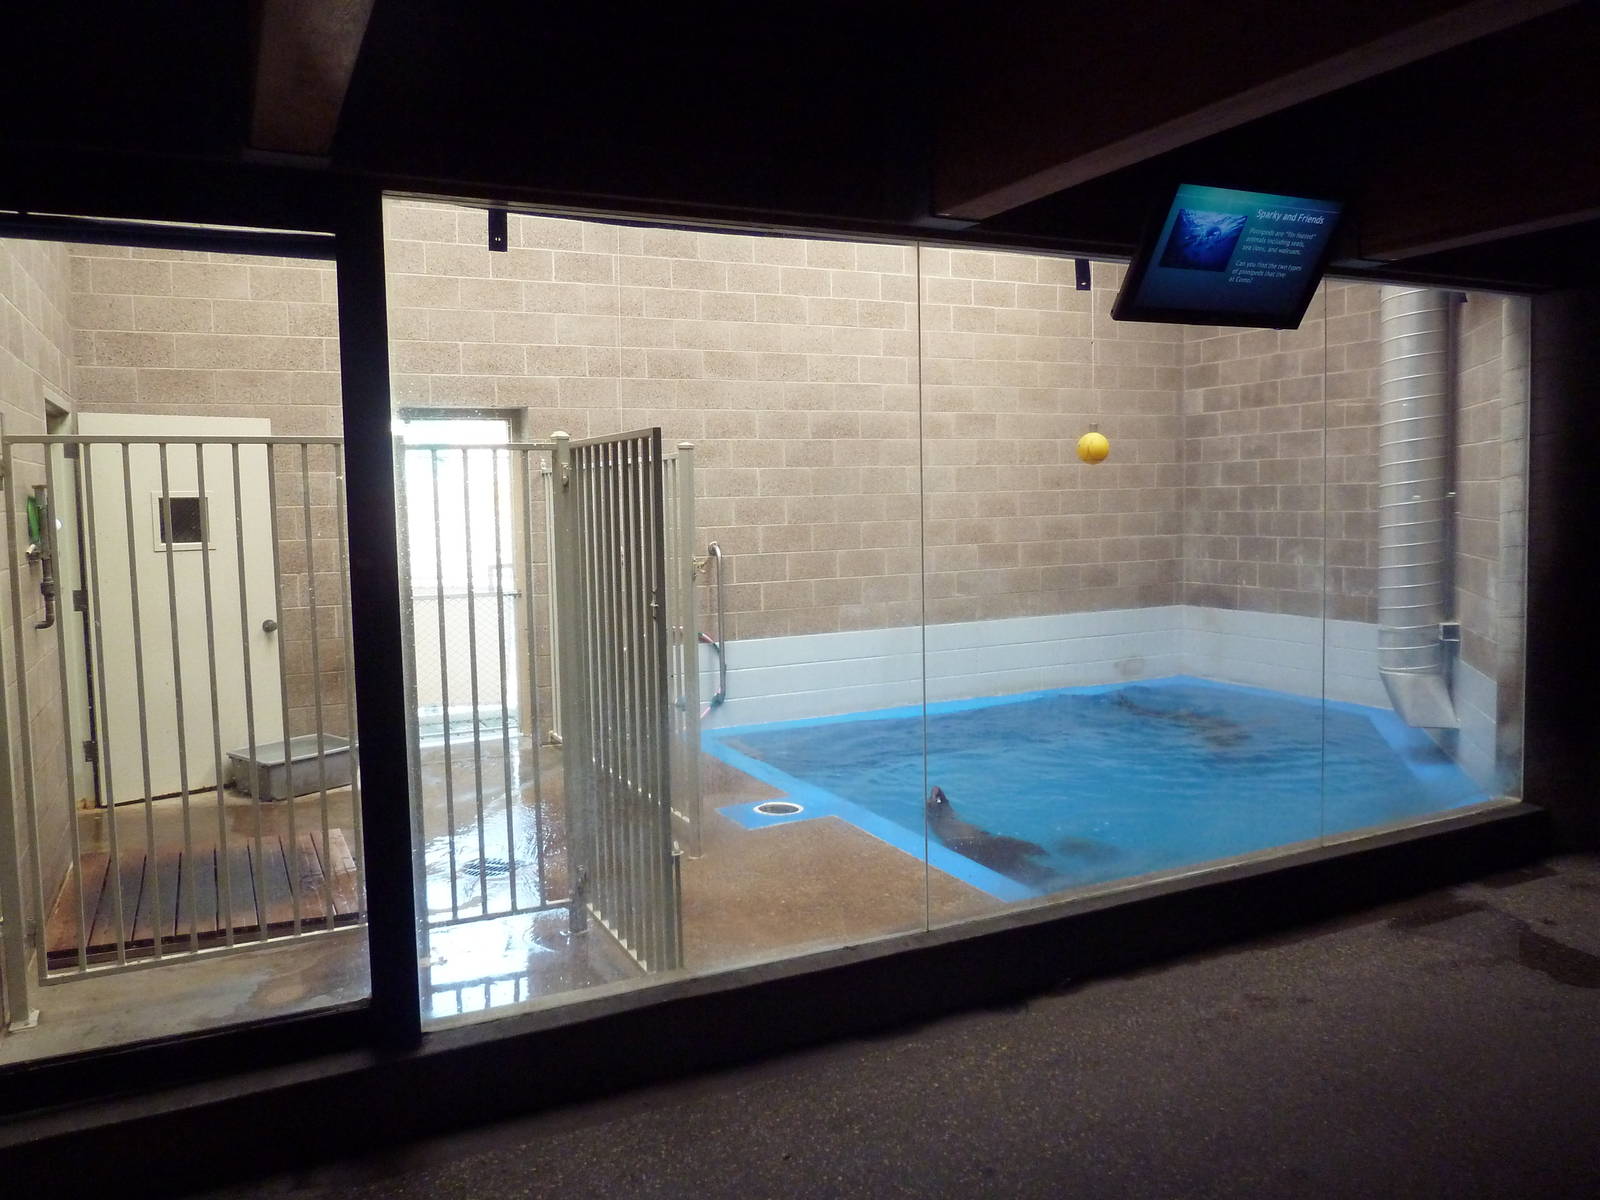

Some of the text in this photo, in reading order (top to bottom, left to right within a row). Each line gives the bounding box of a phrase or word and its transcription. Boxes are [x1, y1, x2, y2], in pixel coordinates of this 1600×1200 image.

[1256, 209, 1325, 225] Sparky and Friends
